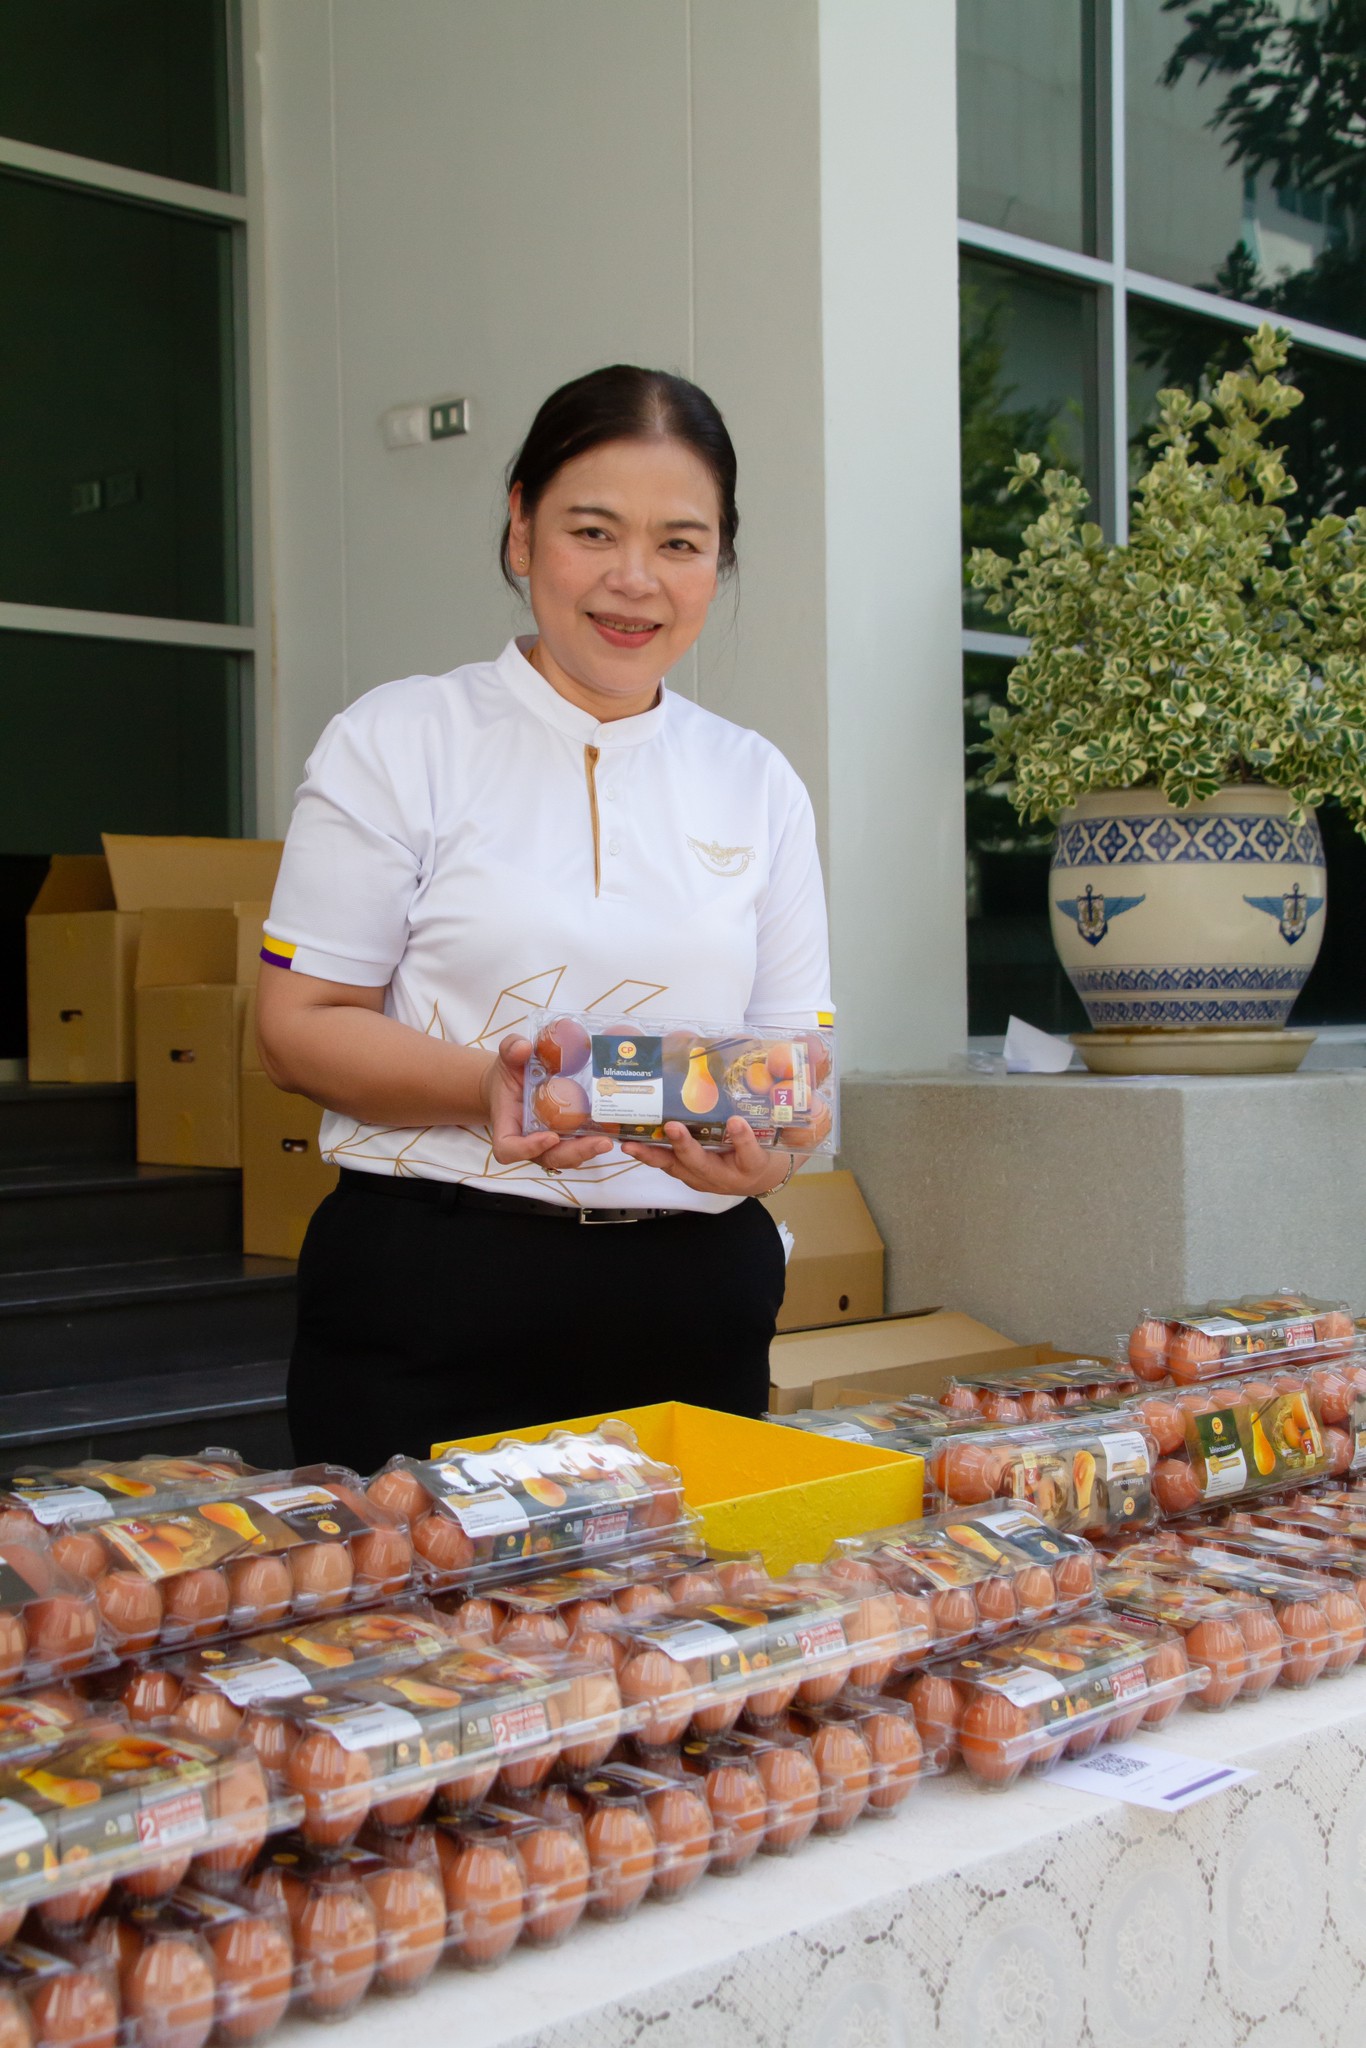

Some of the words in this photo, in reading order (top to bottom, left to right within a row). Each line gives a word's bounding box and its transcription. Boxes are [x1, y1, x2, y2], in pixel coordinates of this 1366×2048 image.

[621, 1046, 634, 1054] CP
[780, 1095, 788, 1105] 2
[1286, 1331, 1294, 1347] 2
[1305, 1445, 1312, 1454] 2
[585, 1525, 595, 1545] 2
[801, 1636, 812, 1657] 2
[141, 1817, 158, 1847] 2
